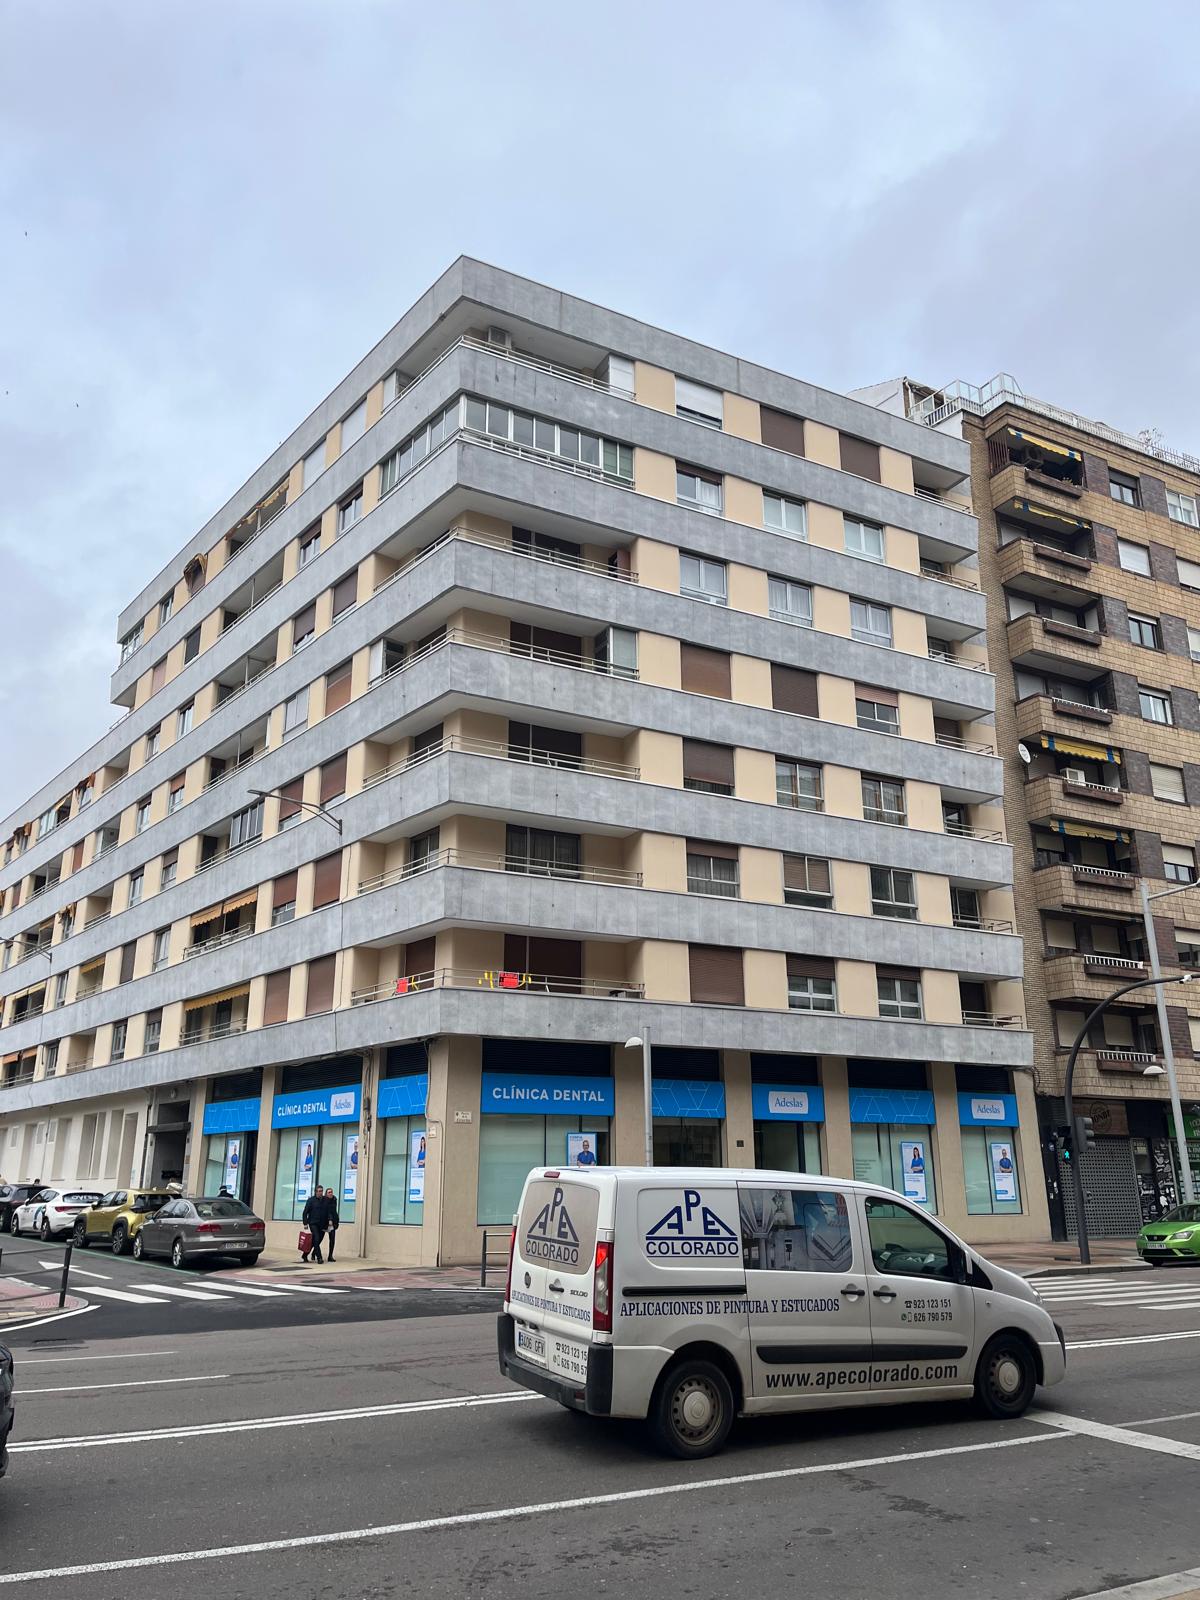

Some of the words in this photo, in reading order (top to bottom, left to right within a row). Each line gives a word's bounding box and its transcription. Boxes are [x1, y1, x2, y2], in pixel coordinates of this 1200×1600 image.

[492, 1085, 549, 1101] CLÍNICA
[553, 1089, 605, 1102] DENTAL
[277, 1103, 301, 1117] CLÍNICA
[302, 1102, 328, 1114] DENTAL
[774, 1096, 804, 1109] Adeslas
[976, 1104, 1001, 1114] Adeslas
[527, 1187, 580, 1243] APE
[645, 1189, 738, 1236] APE
[525, 1240, 579, 1264] COLORADO
[645, 1241, 739, 1255] COLORADO
[534, 1296, 540, 1307] DE
[562, 1304, 591, 1322] ESTUCADOS
[620, 1301, 704, 1317] APLICACIONES
[706, 1300, 721, 1315] DE
[723, 1300, 769, 1314] PINTURA
[771, 1299, 778, 1313] Y
[781, 1298, 840, 1313] ESTUCADOS
[913, 1299, 925, 1309] 923
[927, 1299, 939, 1308] 123
[940, 1299, 951, 1308] 151
[913, 1312, 926, 1322] 626
[927, 1312, 939, 1322] 790
[940, 1312, 953, 1321] 579
[561, 1343, 570, 1355] 923
[571, 1347, 580, 1358] 123
[561, 1357, 570, 1370] 626
[571, 1361, 580, 1373] 790
[580, 1364, 588, 1375] 57
[765, 1363, 958, 1389] www.apecolorado.com
